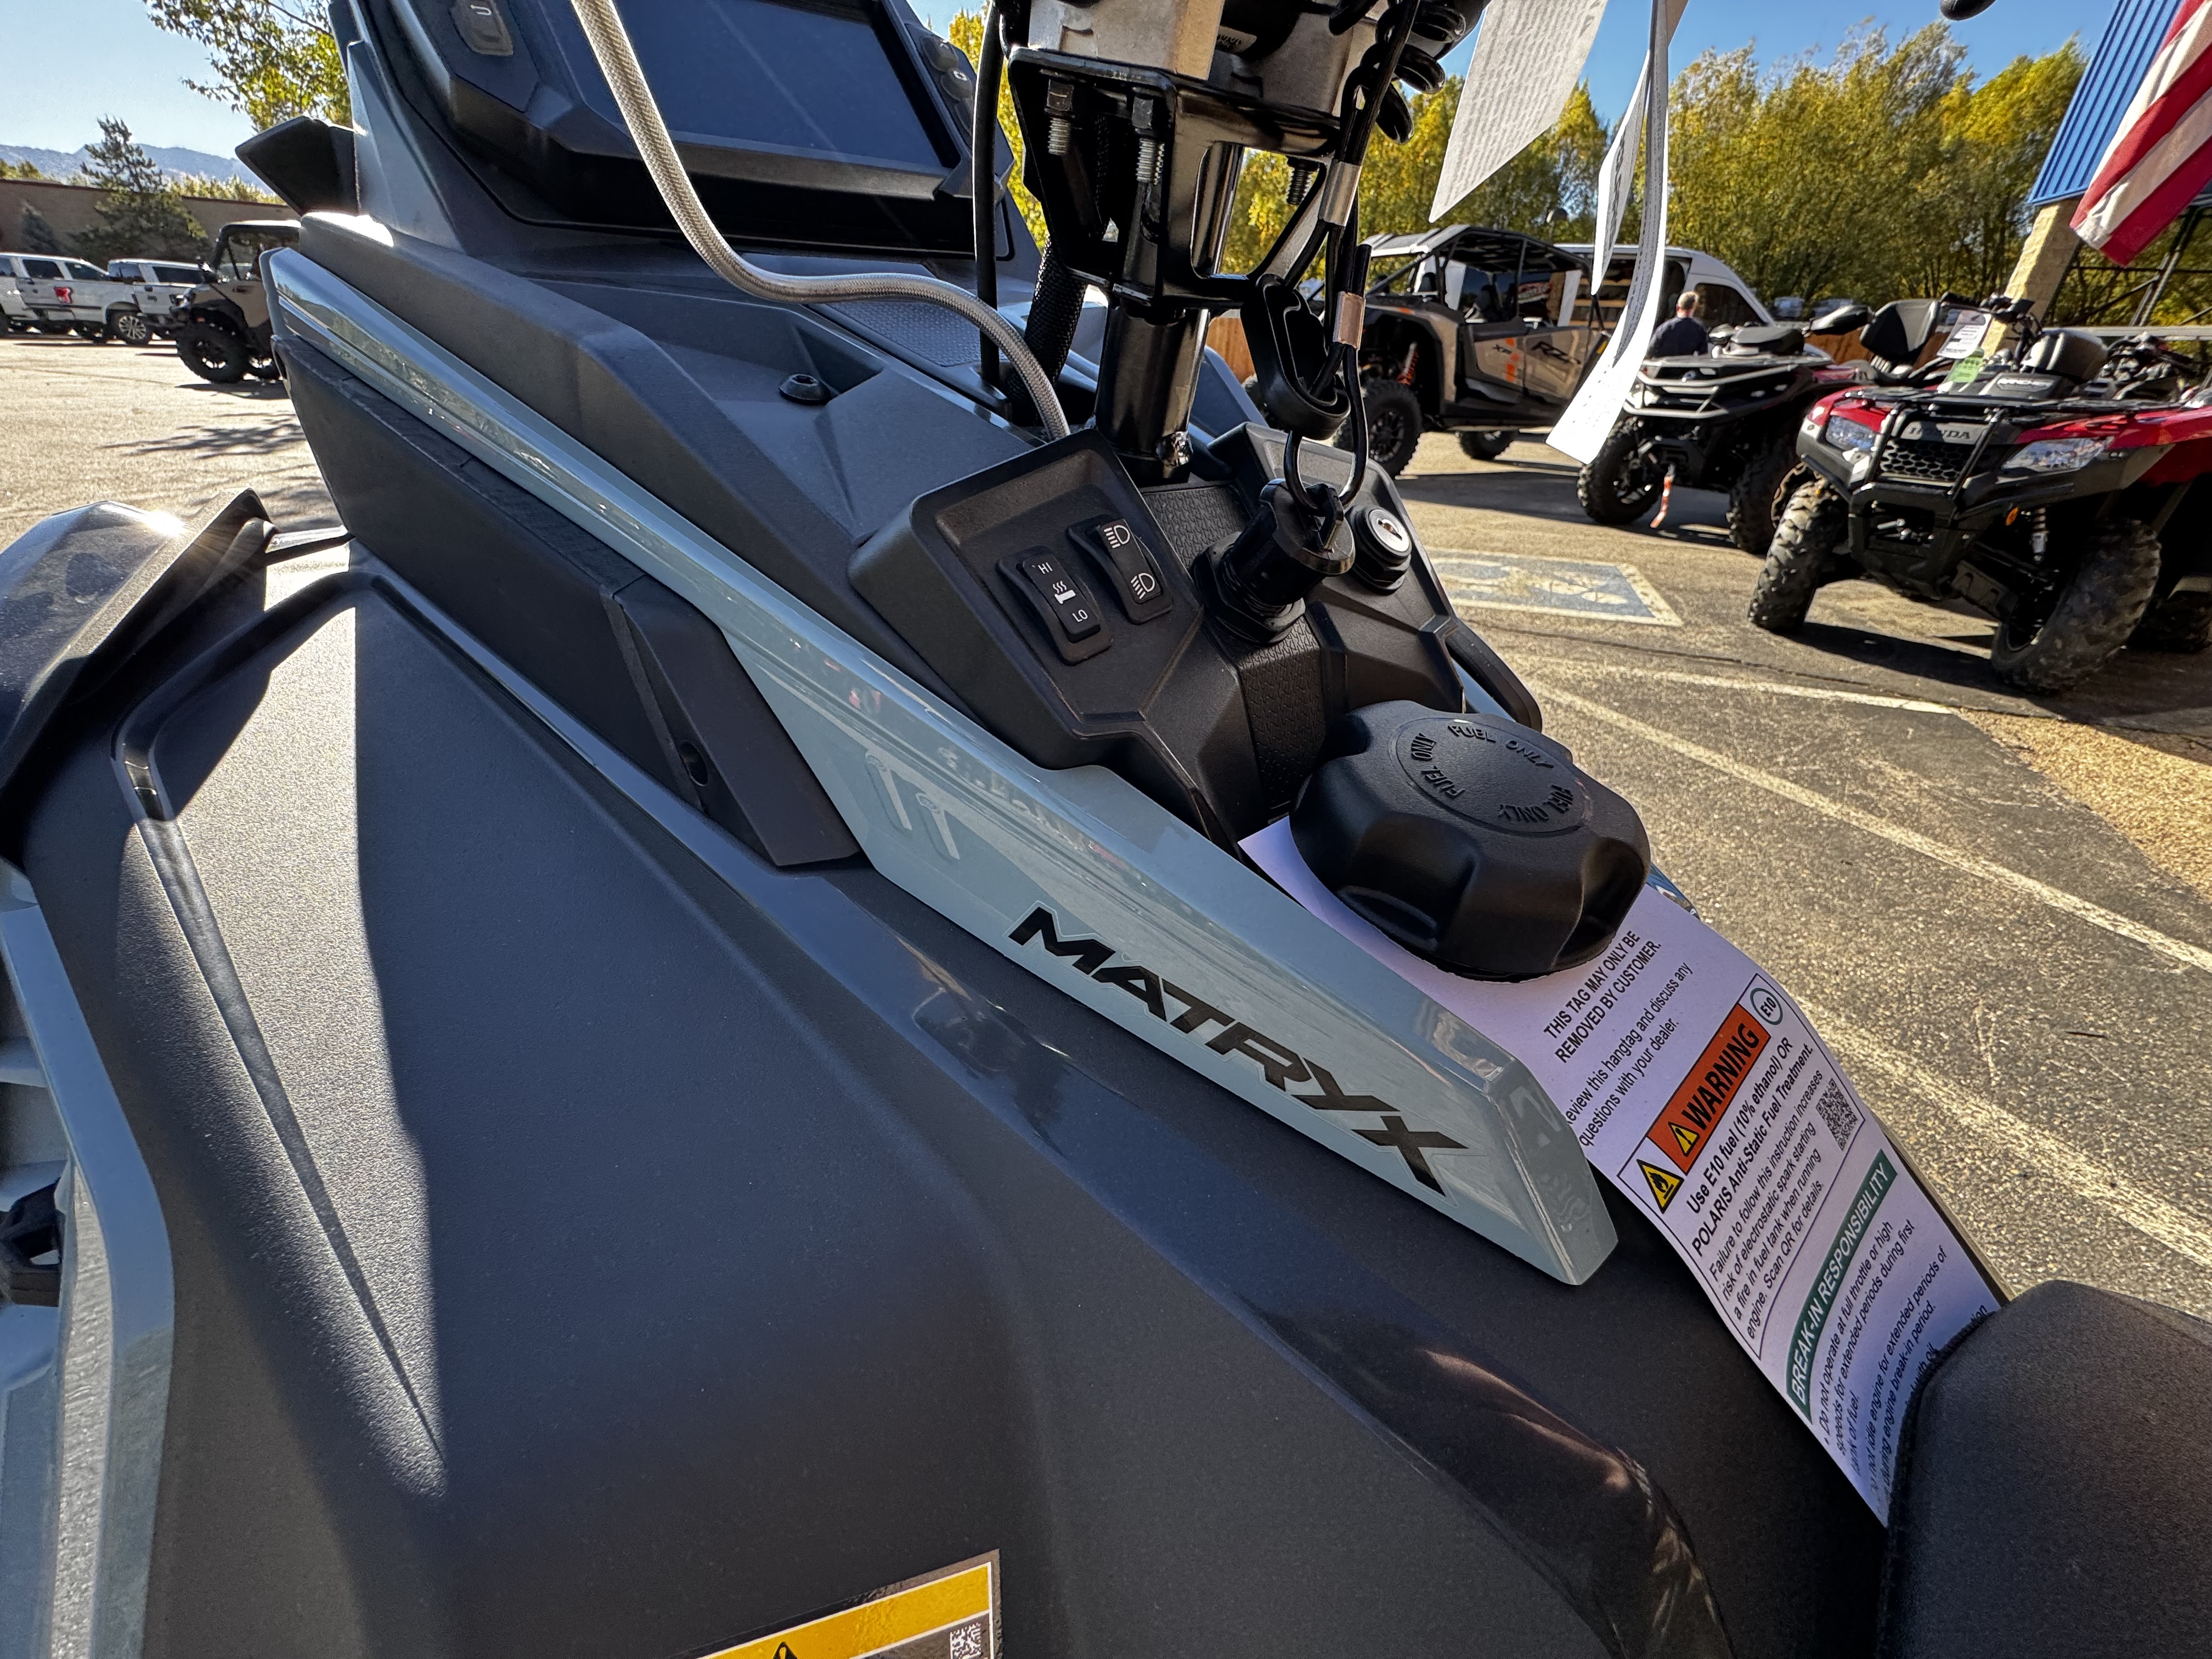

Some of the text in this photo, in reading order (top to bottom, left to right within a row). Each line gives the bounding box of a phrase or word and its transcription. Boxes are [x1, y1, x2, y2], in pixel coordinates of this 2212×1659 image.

[1037, 562, 1053, 574] HI
[1072, 609, 1088, 622] LO
[1411, 733, 1465, 798] FUEL ONLY
[1447, 725, 1554, 769] FUEL ONLY
[1497, 784, 1573, 823] FUEL ONLY
[1543, 930, 1640, 1039] THIS TAG MAY ONLY BE
[1555, 941, 1662, 1063] REMOVED BY CUSTOMER.
[1586, 1069, 1609, 1091] this
[1601, 1029, 1643, 1072] hangtag
[1637, 1008, 1655, 1031] and
[1649, 979, 1679, 1013] discuss
[1674, 962, 1693, 981] any
[1760, 997, 1776, 1018] E10
[1008, 906, 1469, 1197] MATRYX
[1579, 1018, 1679, 1147] questions with your dealer.
[1681, 1023, 1759, 1131] WARNING
[1686, 1037, 1793, 1214] Use E10 fuel (10% ethanol) OR
[1691, 1043, 1814, 1257] POLARIS Anti-Static Fuel Treatment.
[1709, 1070, 1823, 1282] Failure to follow this instruction increases
[1722, 1121, 1816, 1301] risk of electrostatic spark starting
[1734, 1148, 1822, 1321] a fire in fuel tank when running
[1747, 1180, 1824, 1340] engine. Scan QR for details.
[1938, 1244, 1946, 1262] of
[1790, 1162, 1889, 1405] BREAK-IN RESPONSIBILITY
[1819, 1222, 1893, 1436] Do not operate at full throttle or high
[1832, 1219, 1915, 1456] speeds for extended periods during first
[1887, 1297, 1915, 1356] extended
[1913, 1261, 1939, 1306] periods
[1870, 1374, 1883, 1421] engine
[1878, 1353, 1889, 1375] for
[1883, 1390, 1896, 1438] engine
[1890, 1339, 1914, 1391] break-in
[1911, 1300, 1937, 1344] period.
[1847, 1417, 1856, 1440] of
[1865, 1421, 1876, 1450] idle
